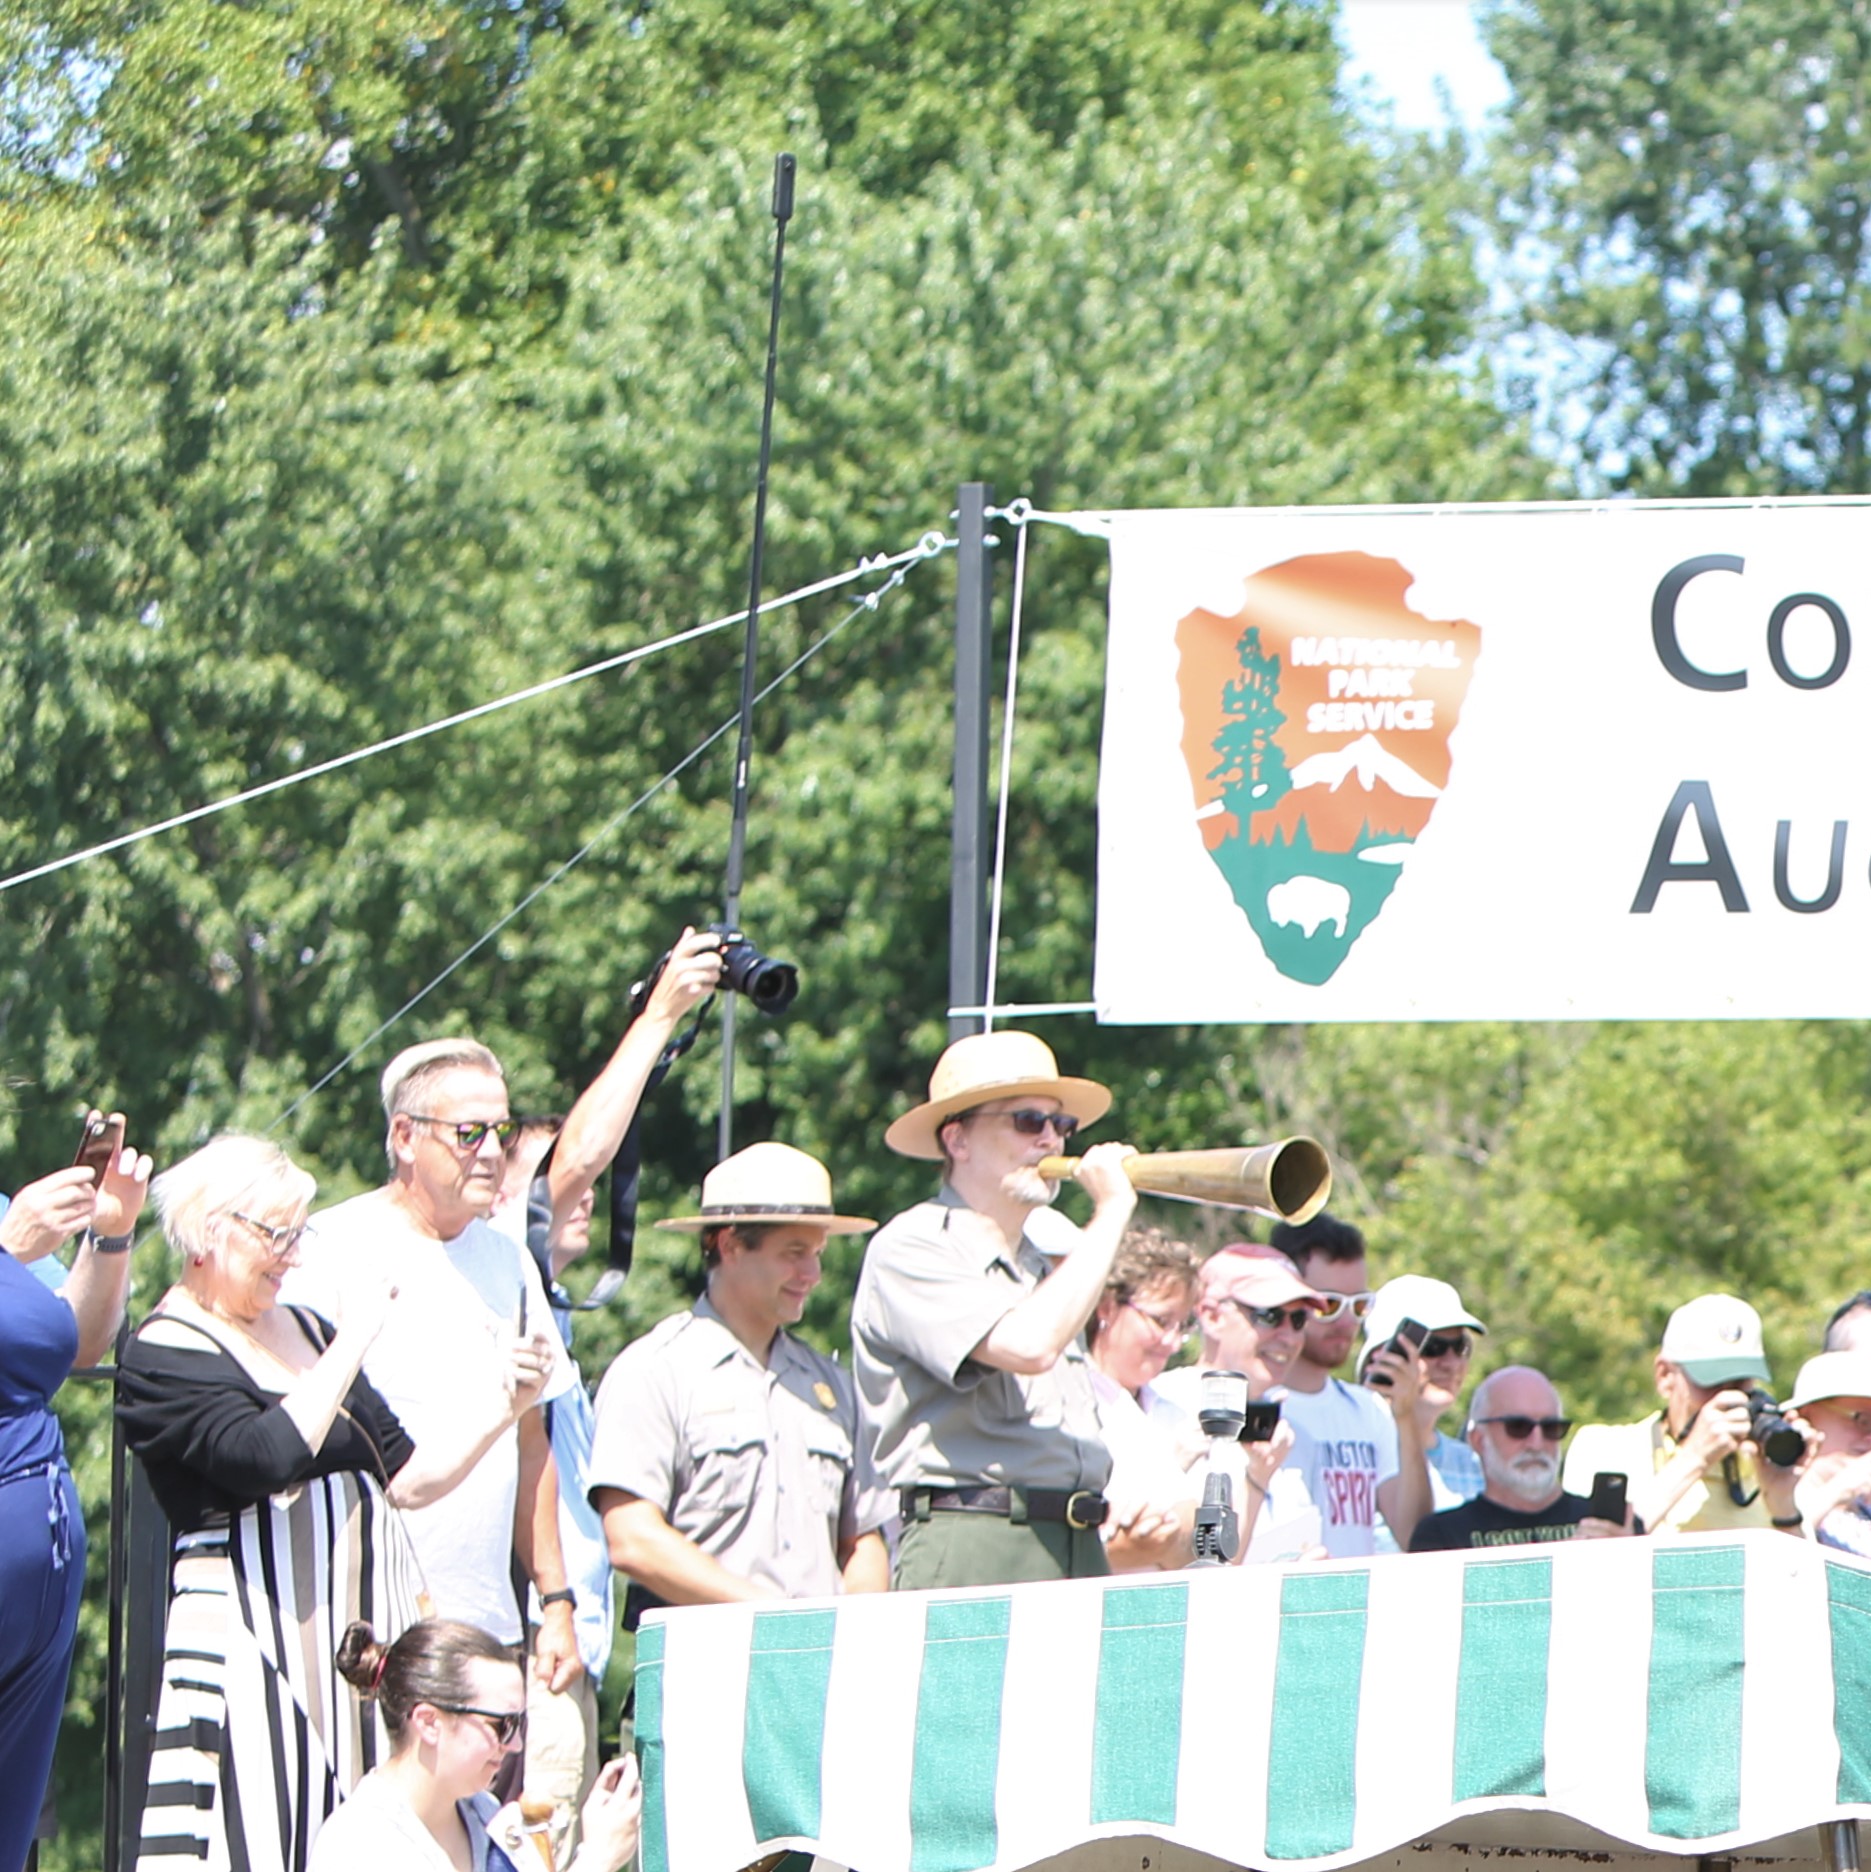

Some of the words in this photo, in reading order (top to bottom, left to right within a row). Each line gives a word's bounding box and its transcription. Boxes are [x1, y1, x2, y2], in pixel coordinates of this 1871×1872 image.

[1291, 637, 1460, 668] NATIONAL
[1328, 668, 1417, 699] PARK
[1307, 699, 1434, 733] SERVICE
